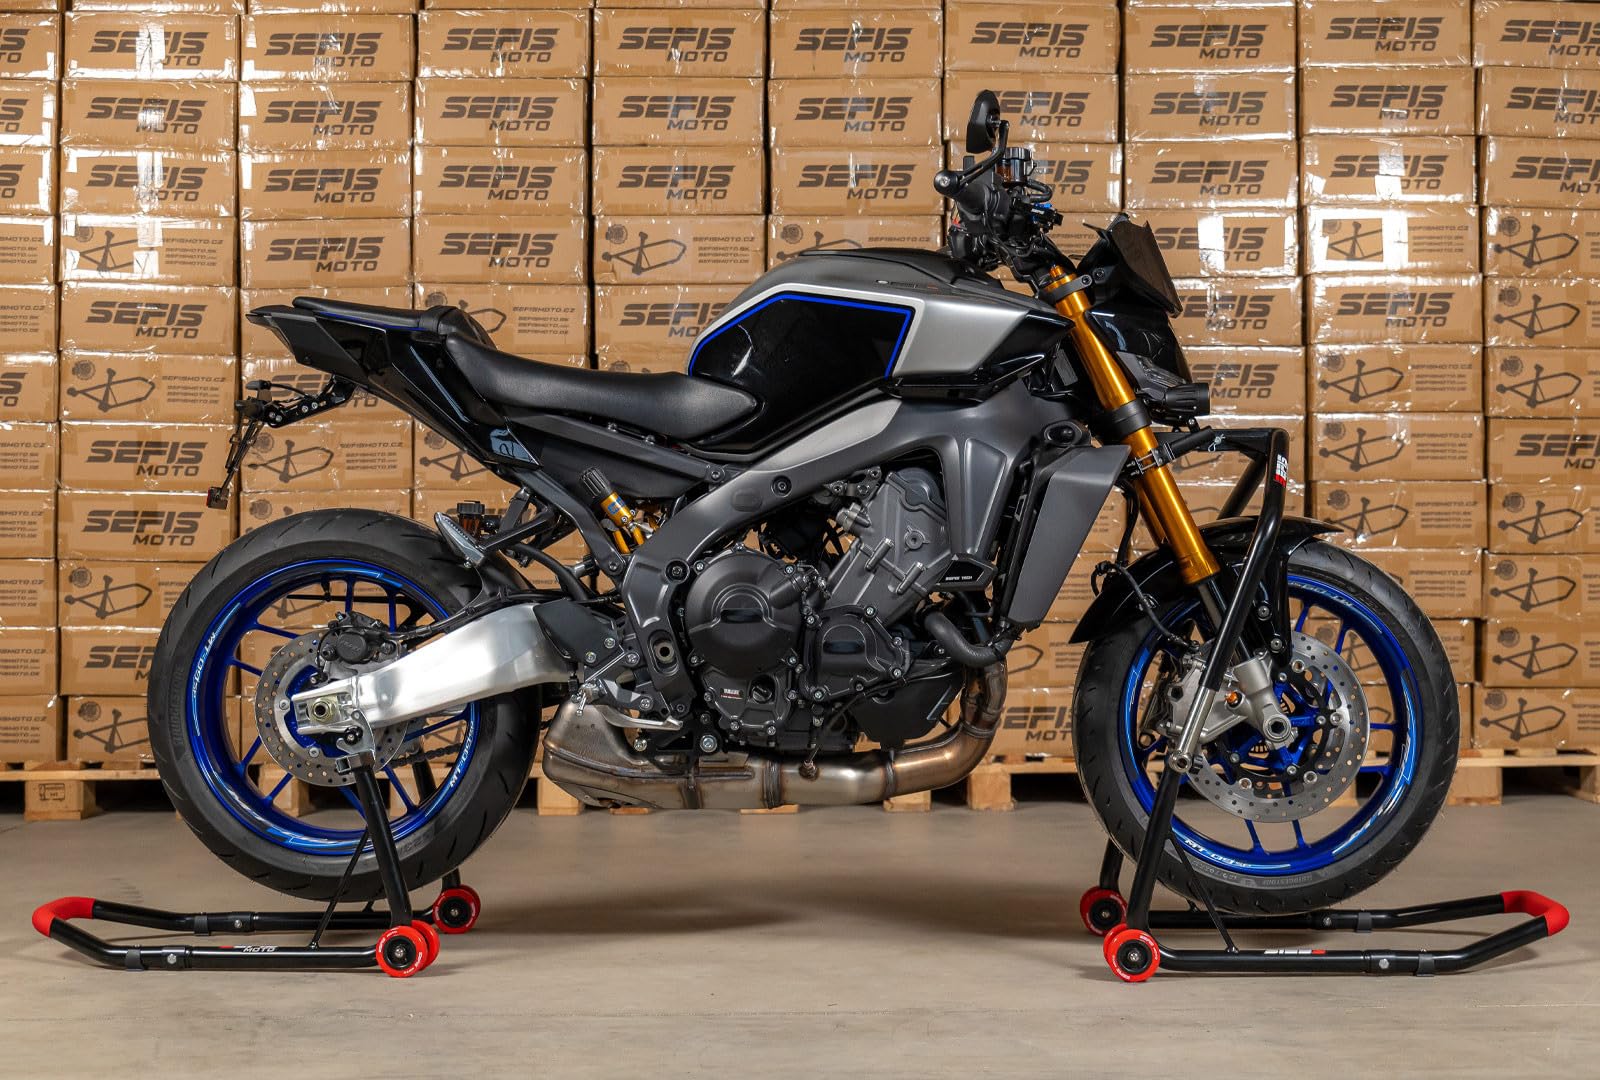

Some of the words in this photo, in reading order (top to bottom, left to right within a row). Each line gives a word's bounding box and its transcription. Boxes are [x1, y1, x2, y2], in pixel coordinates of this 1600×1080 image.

[971, 22, 1089, 46] SEFIS
[1326, 17, 1444, 40] SEFIS
[89, 31, 209, 53] SEIS
[442, 28, 560, 51] SEFIS
[618, 28, 736, 50] SEFIS
[795, 28, 913, 51] SEFIS
[1151, 24, 1269, 47] SEFIS
[264, 33, 383, 55] SEFIS
[1375, 40, 1436, 52] MOTO
[0, 52, 22, 63] TO
[491, 51, 552, 63] MOTO
[667, 50, 728, 63] MOTO
[844, 51, 905, 63] MOTO
[1019, 47, 1081, 58] MOTO
[1199, 48, 1260, 59] MOTO
[161, 53, 201, 66] OTO
[998, 91, 1090, 115] EFIS
[1150, 91, 1267, 115] SEFIS
[1331, 85, 1448, 108] SEFIS
[86, 97, 208, 122] SEFIS
[264, 100, 383, 123] SEFIS
[440, 96, 559, 118] SEFIS
[618, 96, 736, 118] SEFIS
[795, 97, 913, 120] SEFIS
[667, 118, 729, 130] MOTO
[1020, 115, 1082, 127] MOTO
[1199, 115, 1260, 126] MOTO
[1553, 112, 1600, 124] MOT
[314, 124, 375, 135] MOTO
[490, 119, 551, 131] MOTO
[844, 120, 906, 132] MOTO
[1036, 160, 1094, 183] FIS
[1151, 160, 1270, 183] SEFIS
[1510, 156, 1600, 180] SEFI
[263, 168, 383, 192] SEFIS
[439, 166, 556, 188] SEFIS
[618, 165, 735, 188] SEFIS
[798, 164, 916, 188] SEFIS
[1055, 184, 1086, 196] TO
[1200, 183, 1262, 195] MOTO
[1400, 178, 1442, 190] OTO
[1559, 181, 1600, 194] MOT
[158, 190, 199, 202] OTO
[314, 191, 375, 203] MOTO
[488, 189, 549, 200] MOTO
[667, 188, 728, 200] MOTO
[847, 188, 908, 199] MOTO
[440, 233, 558, 255] SEFIS
[1154, 227, 1268, 250] SEIS
[265, 237, 384, 262] SEFIS
[489, 256, 550, 268] MOTO
[1224, 251, 1261, 262] TO
[316, 261, 377, 273] MOTO
[1178, 295, 1274, 318] EFIS
[1337, 292, 1455, 316] SEFIS
[86, 301, 208, 324] SEFIS
[1385, 316, 1447, 328] MOTO
[135, 326, 199, 339] MOTO
[668, 326, 702, 338] MO
[1189, 364, 1280, 386] EFIS
[1210, 388, 1271, 398] MOTO
[342, 397, 378, 407] TO
[86, 440, 208, 463] SEFIS
[136, 465, 200, 476] MOTO
[82, 510, 204, 533] SEFIS
[133, 534, 195, 546] MOTO
[85, 646, 154, 669] SEF
[1026, 730, 1073, 741] MOT
[242, 945, 277, 953] MOTO
